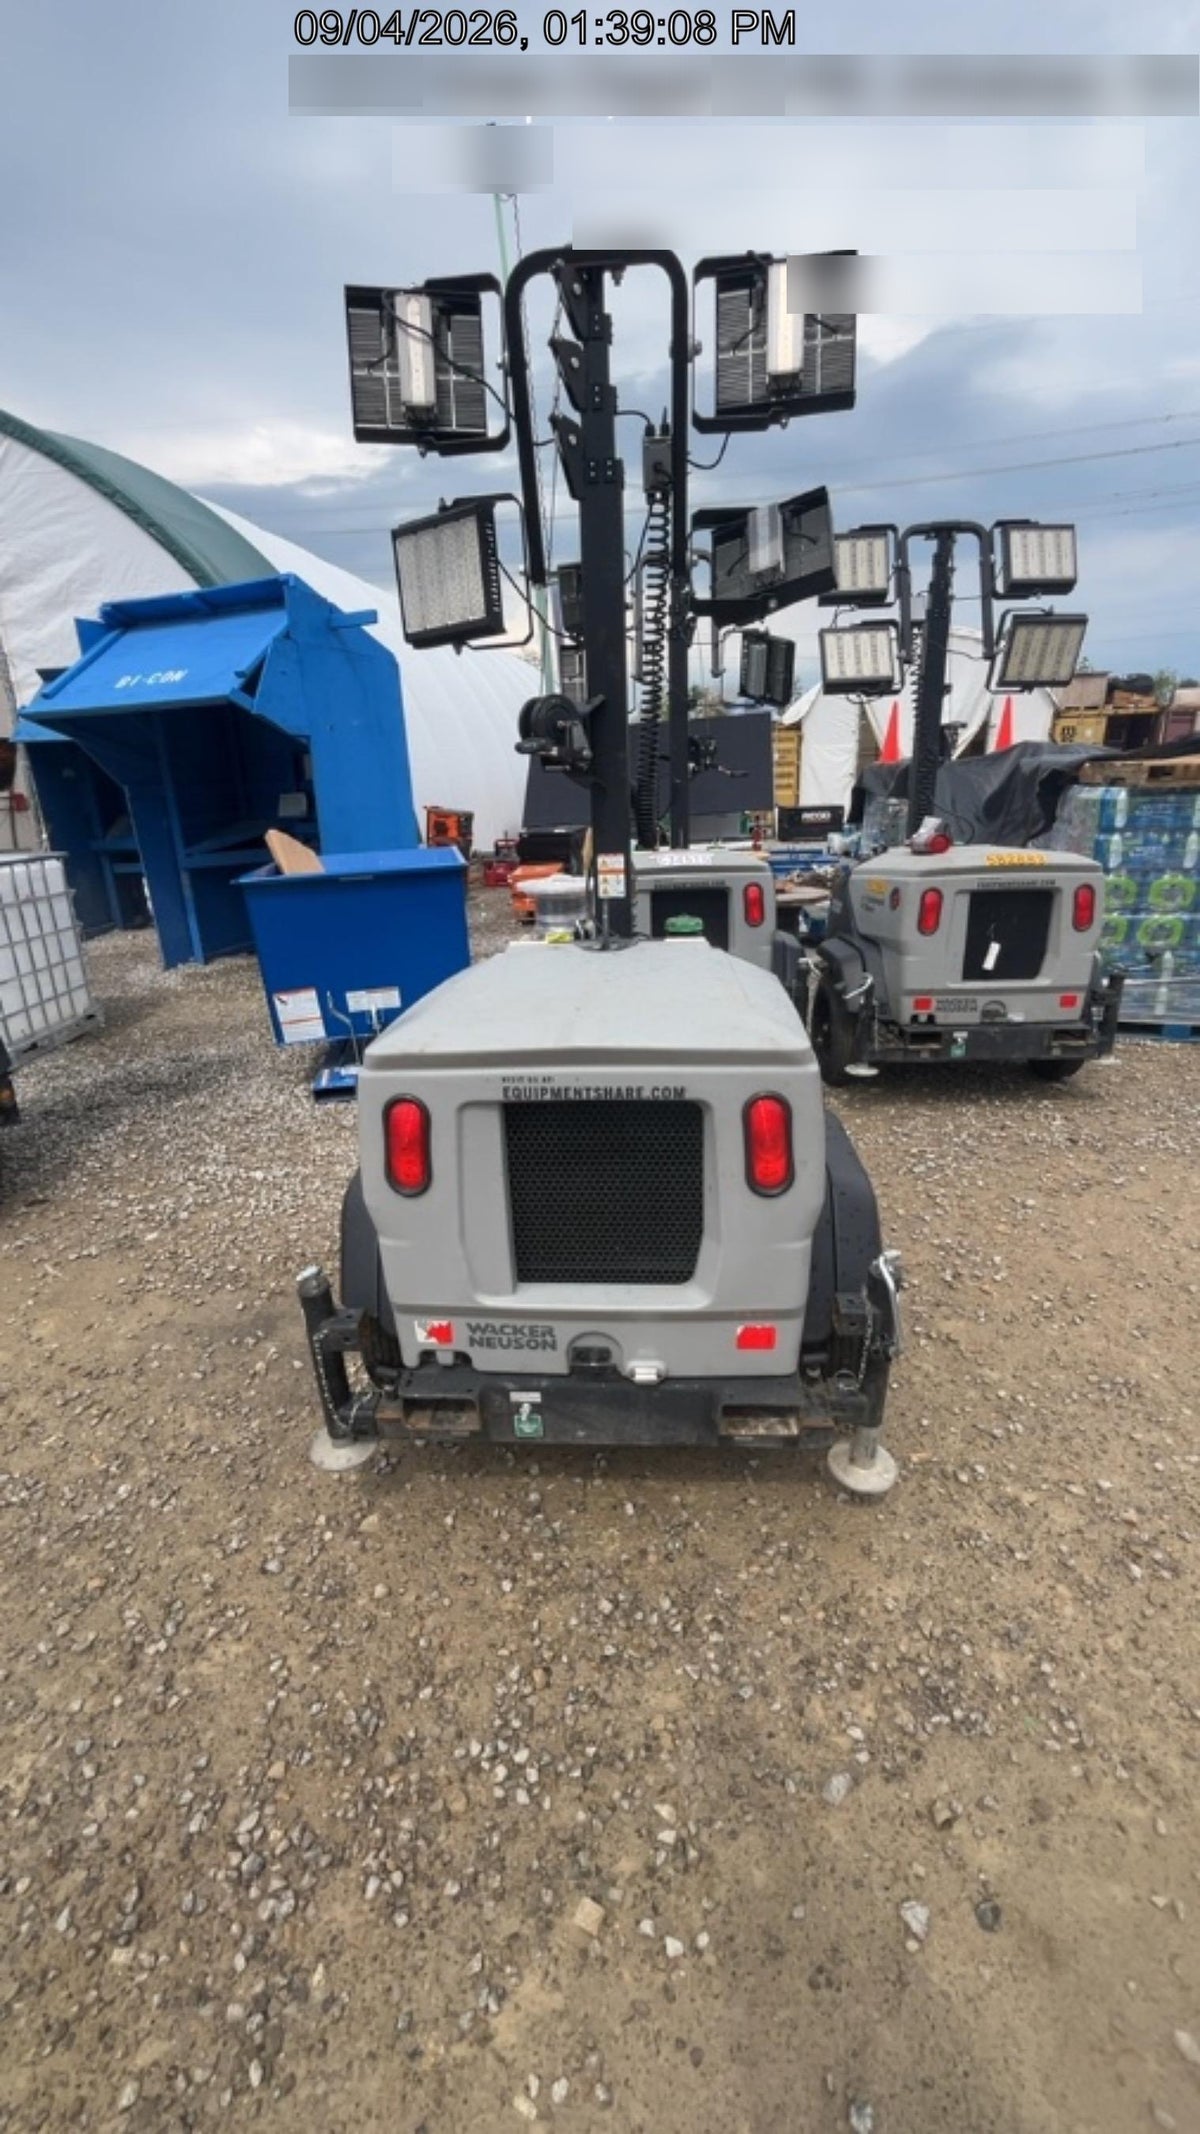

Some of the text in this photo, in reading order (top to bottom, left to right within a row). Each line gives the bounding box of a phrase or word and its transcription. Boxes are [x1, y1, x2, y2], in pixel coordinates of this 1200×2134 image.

[502, 1085, 686, 1100] EQUIPMENTSHARE.COM
[466, 1322, 555, 1338] WACKER
[468, 1337, 557, 1351] NEUSON
